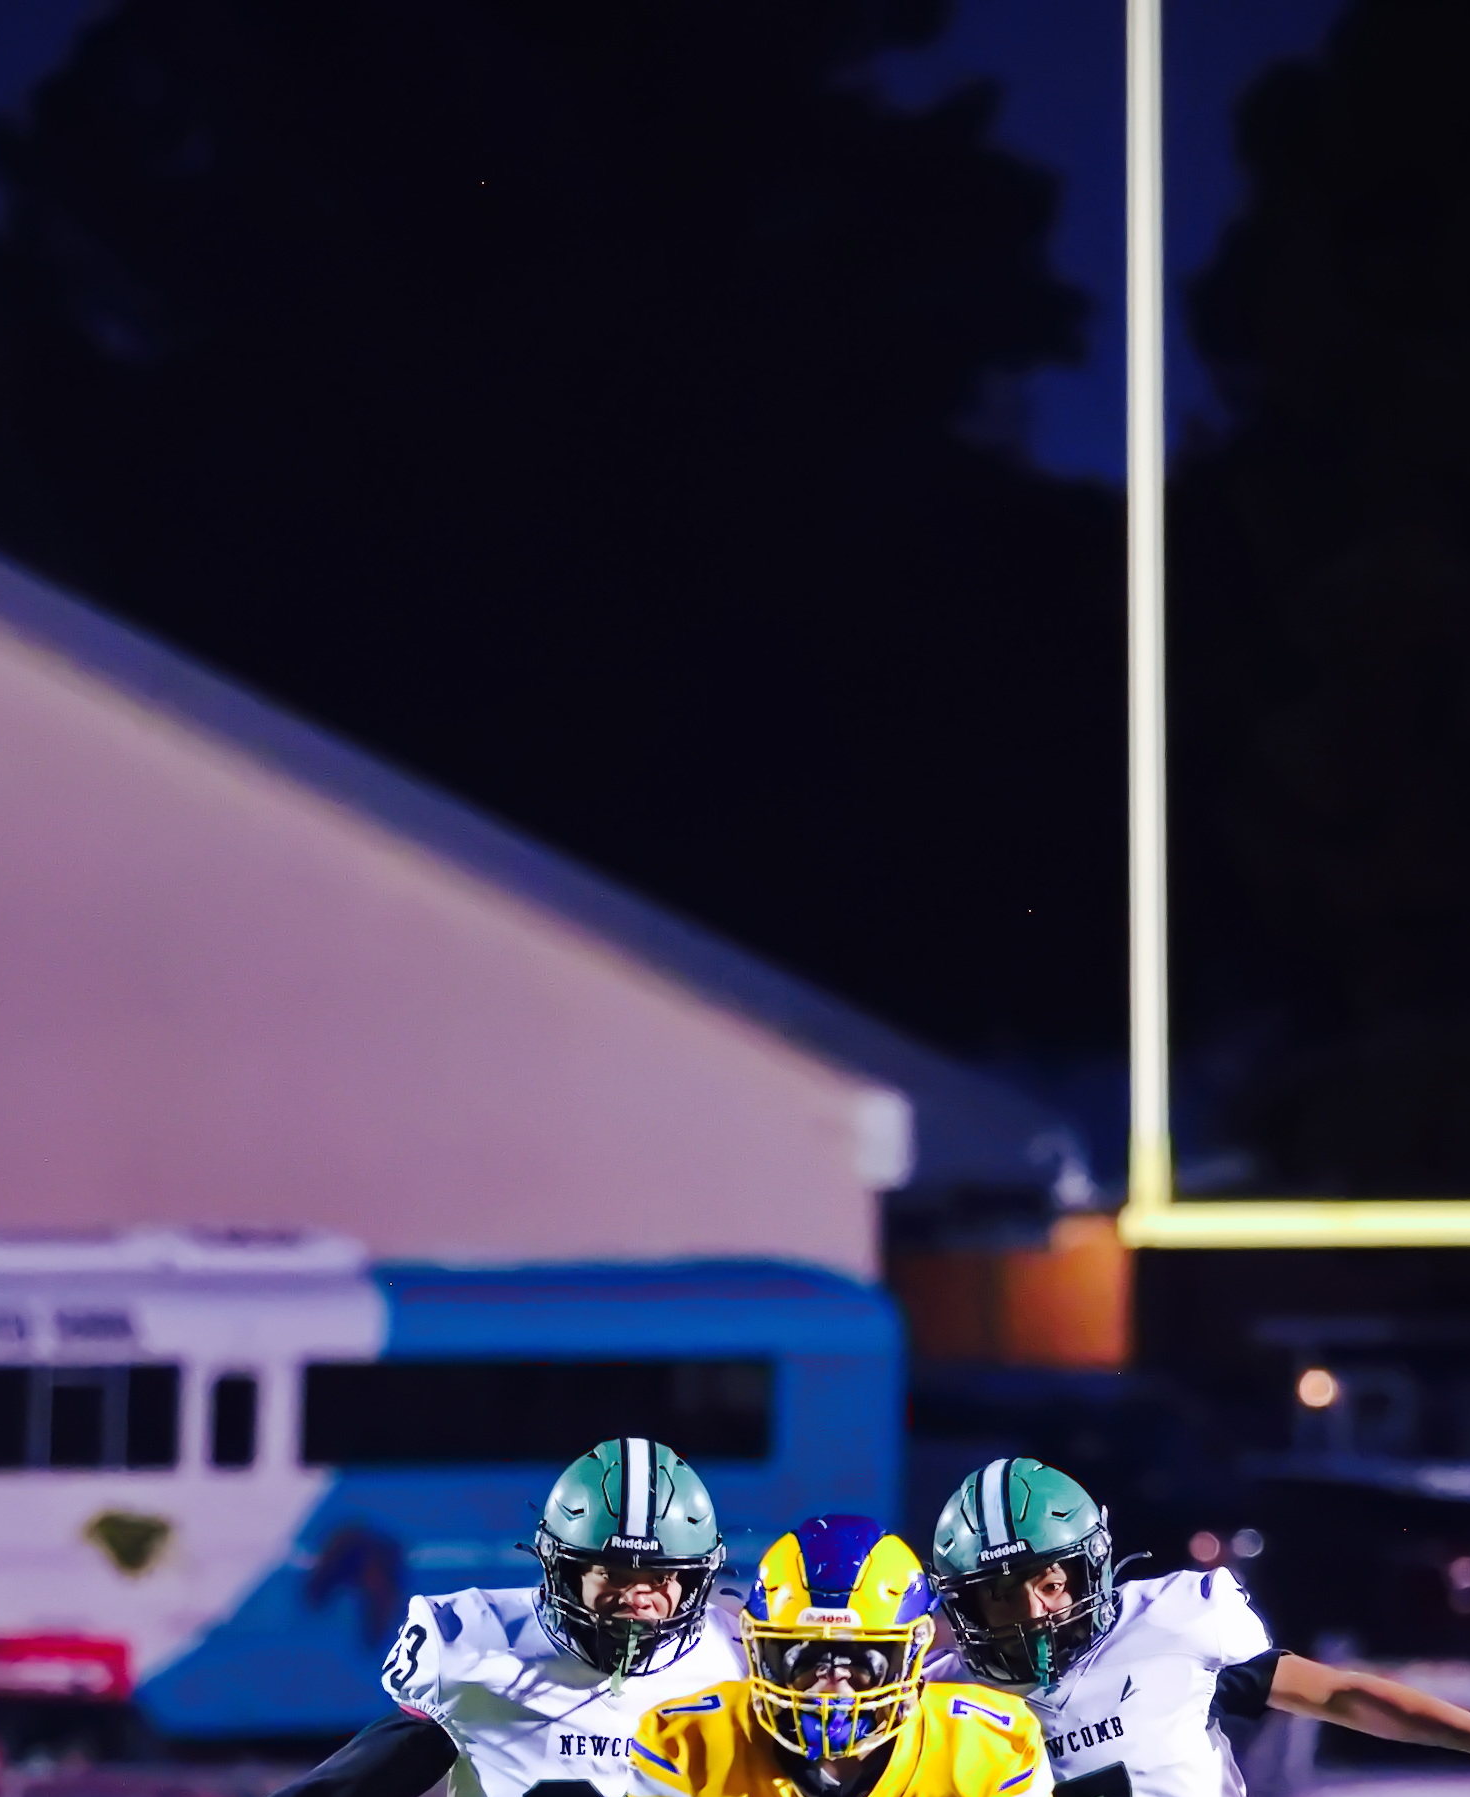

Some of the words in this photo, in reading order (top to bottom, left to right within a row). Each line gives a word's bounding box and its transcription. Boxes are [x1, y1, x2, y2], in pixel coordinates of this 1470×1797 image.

[611, 1535, 659, 1551] Riddell
[980, 1540, 1027, 1561] Riddell
[660, 1693, 723, 1716] 7
[949, 1697, 1012, 1728] 7
[558, 1733, 635, 1758] NEWCO
[1044, 1715, 1125, 1759] WCOMB
